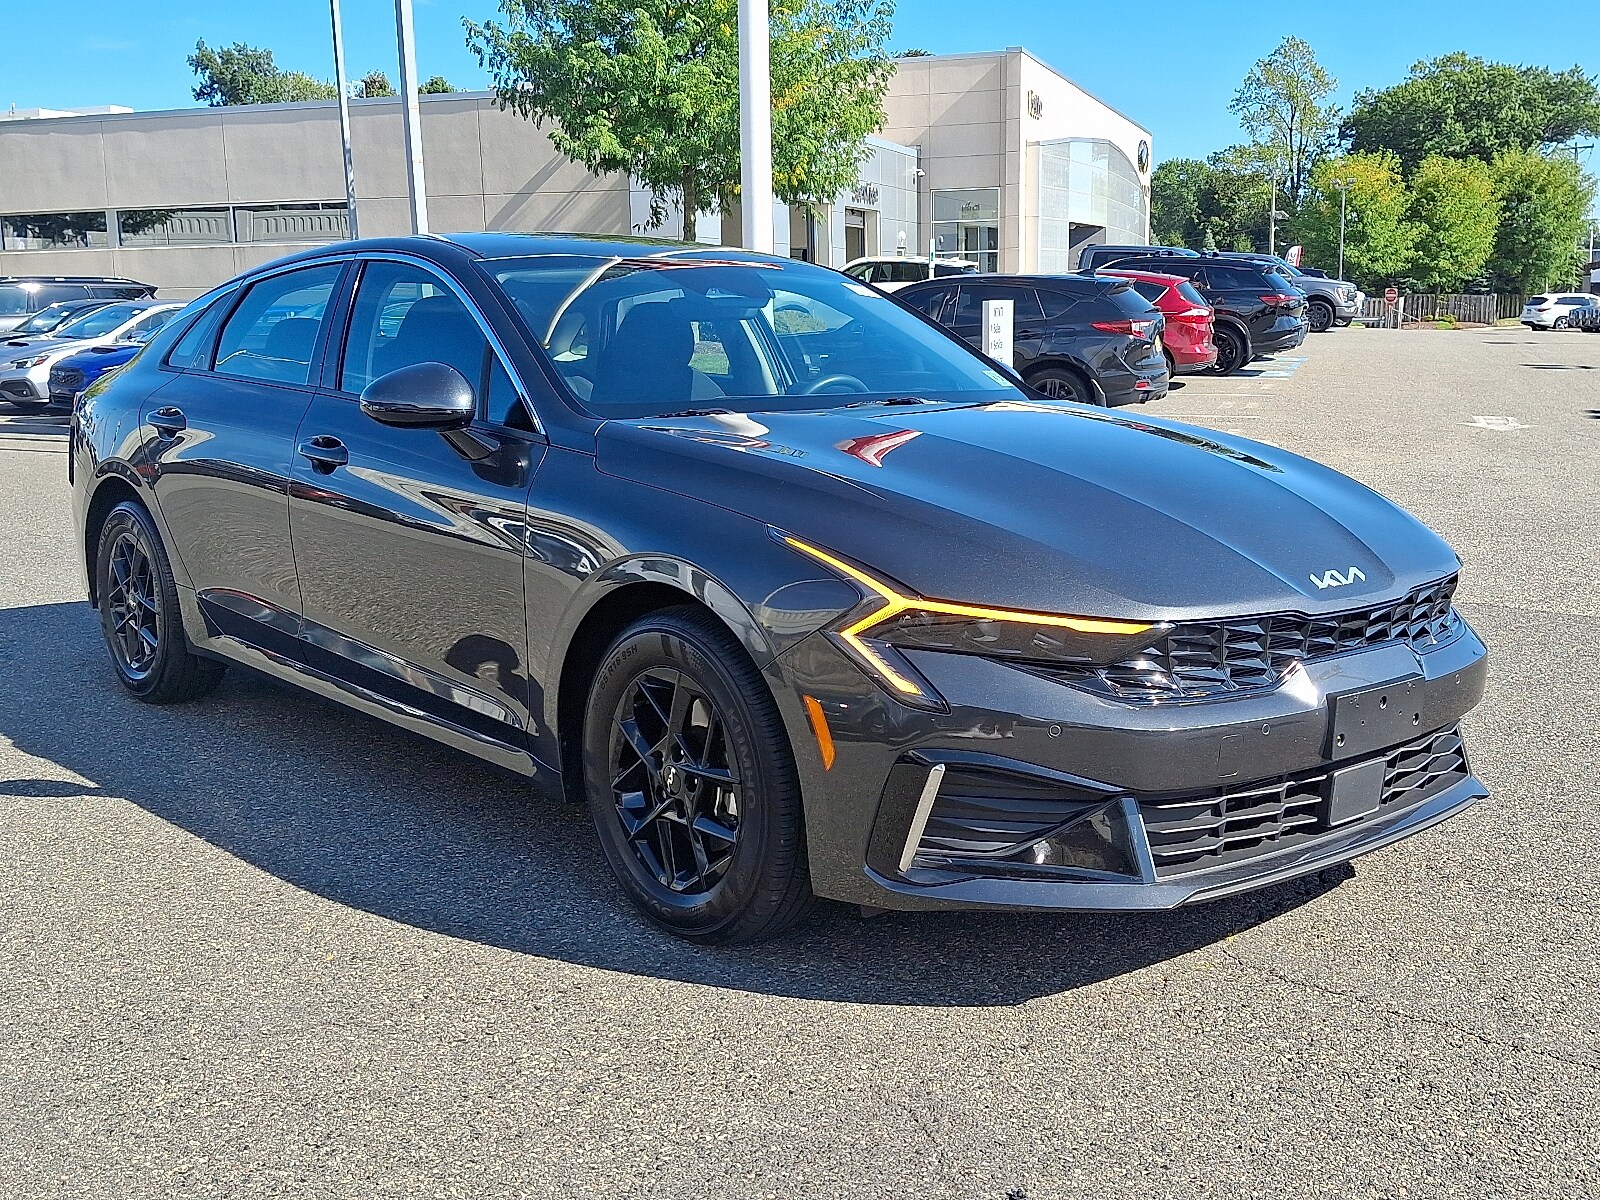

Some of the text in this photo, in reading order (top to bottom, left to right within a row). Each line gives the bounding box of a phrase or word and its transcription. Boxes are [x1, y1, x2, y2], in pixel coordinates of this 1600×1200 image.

[1309, 566, 1366, 589] KIA
[621, 643, 638, 661] 95H
[727, 708, 756, 809] KUMHO
